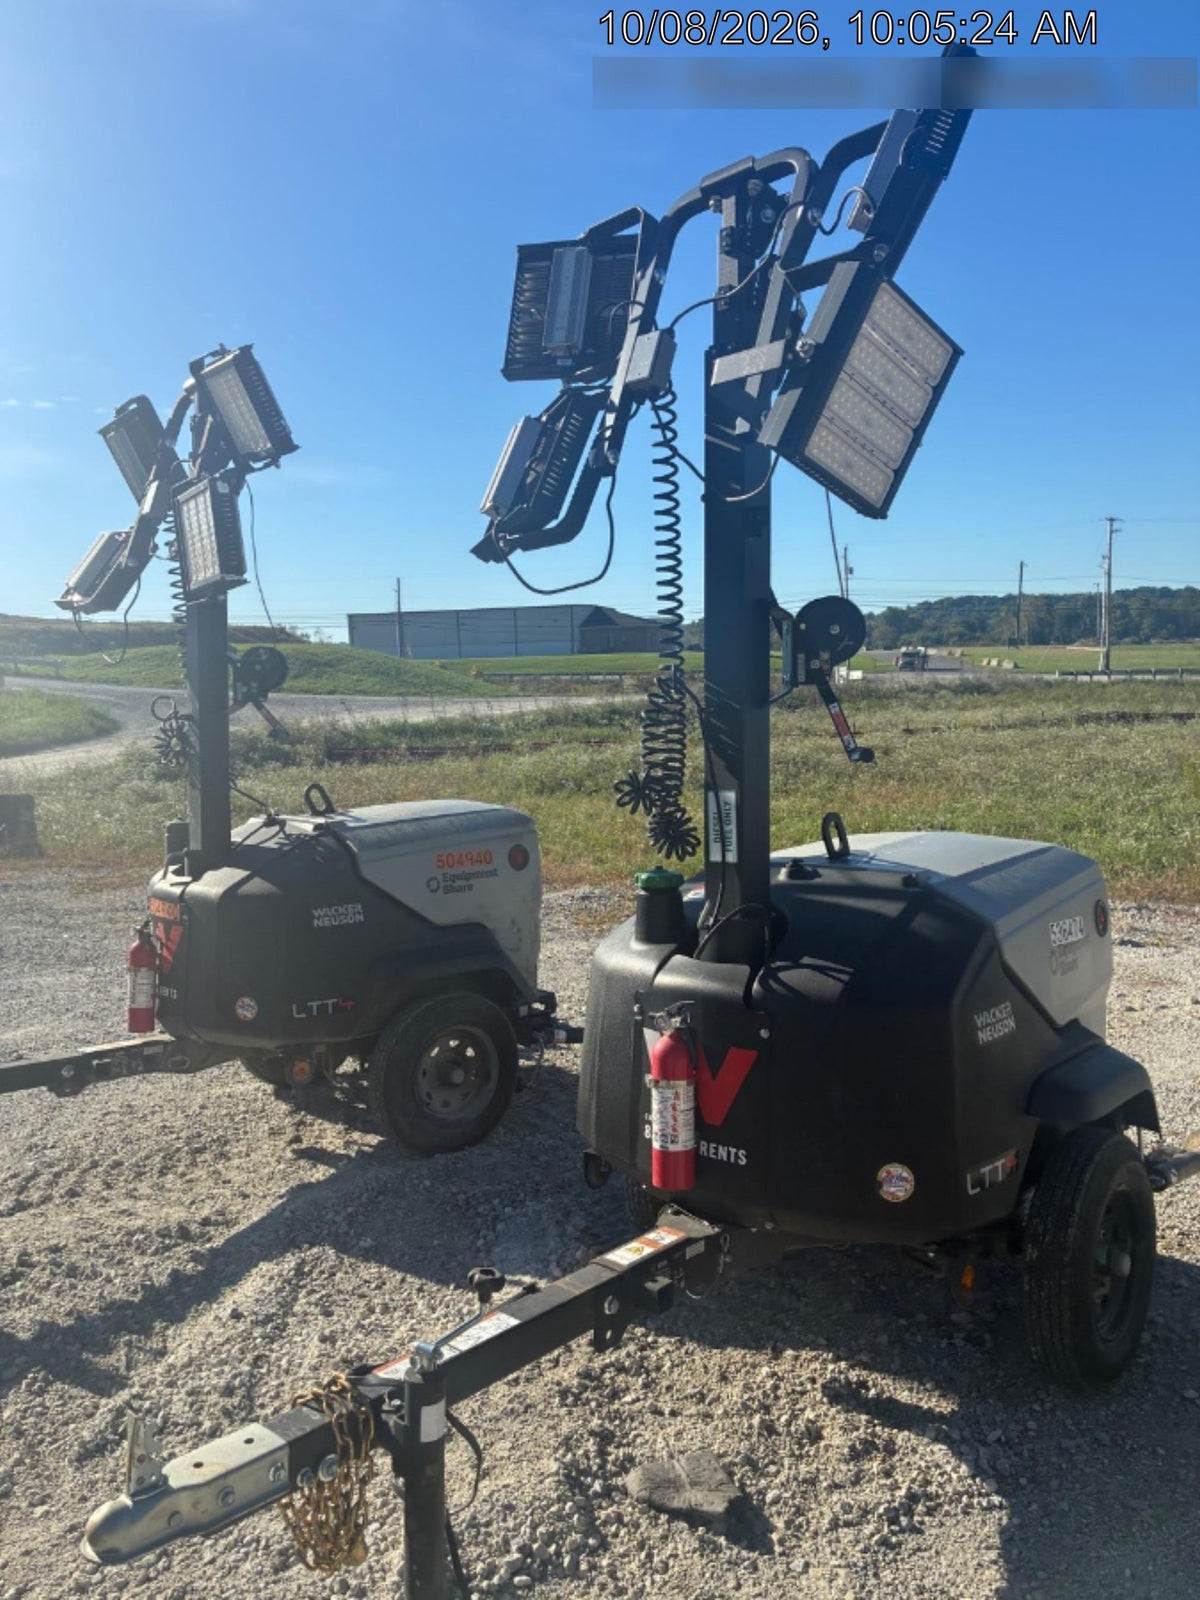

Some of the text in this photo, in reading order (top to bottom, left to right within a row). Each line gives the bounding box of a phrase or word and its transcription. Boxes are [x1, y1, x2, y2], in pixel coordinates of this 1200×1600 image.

[722, 800, 732, 826] ONLY
[442, 868, 499, 883] Equipment
[442, 883, 474, 895] Share
[313, 911, 365, 927] NEUSON
[977, 1016, 1016, 1045] NEUSON
[699, 1140, 748, 1166] RENTS
